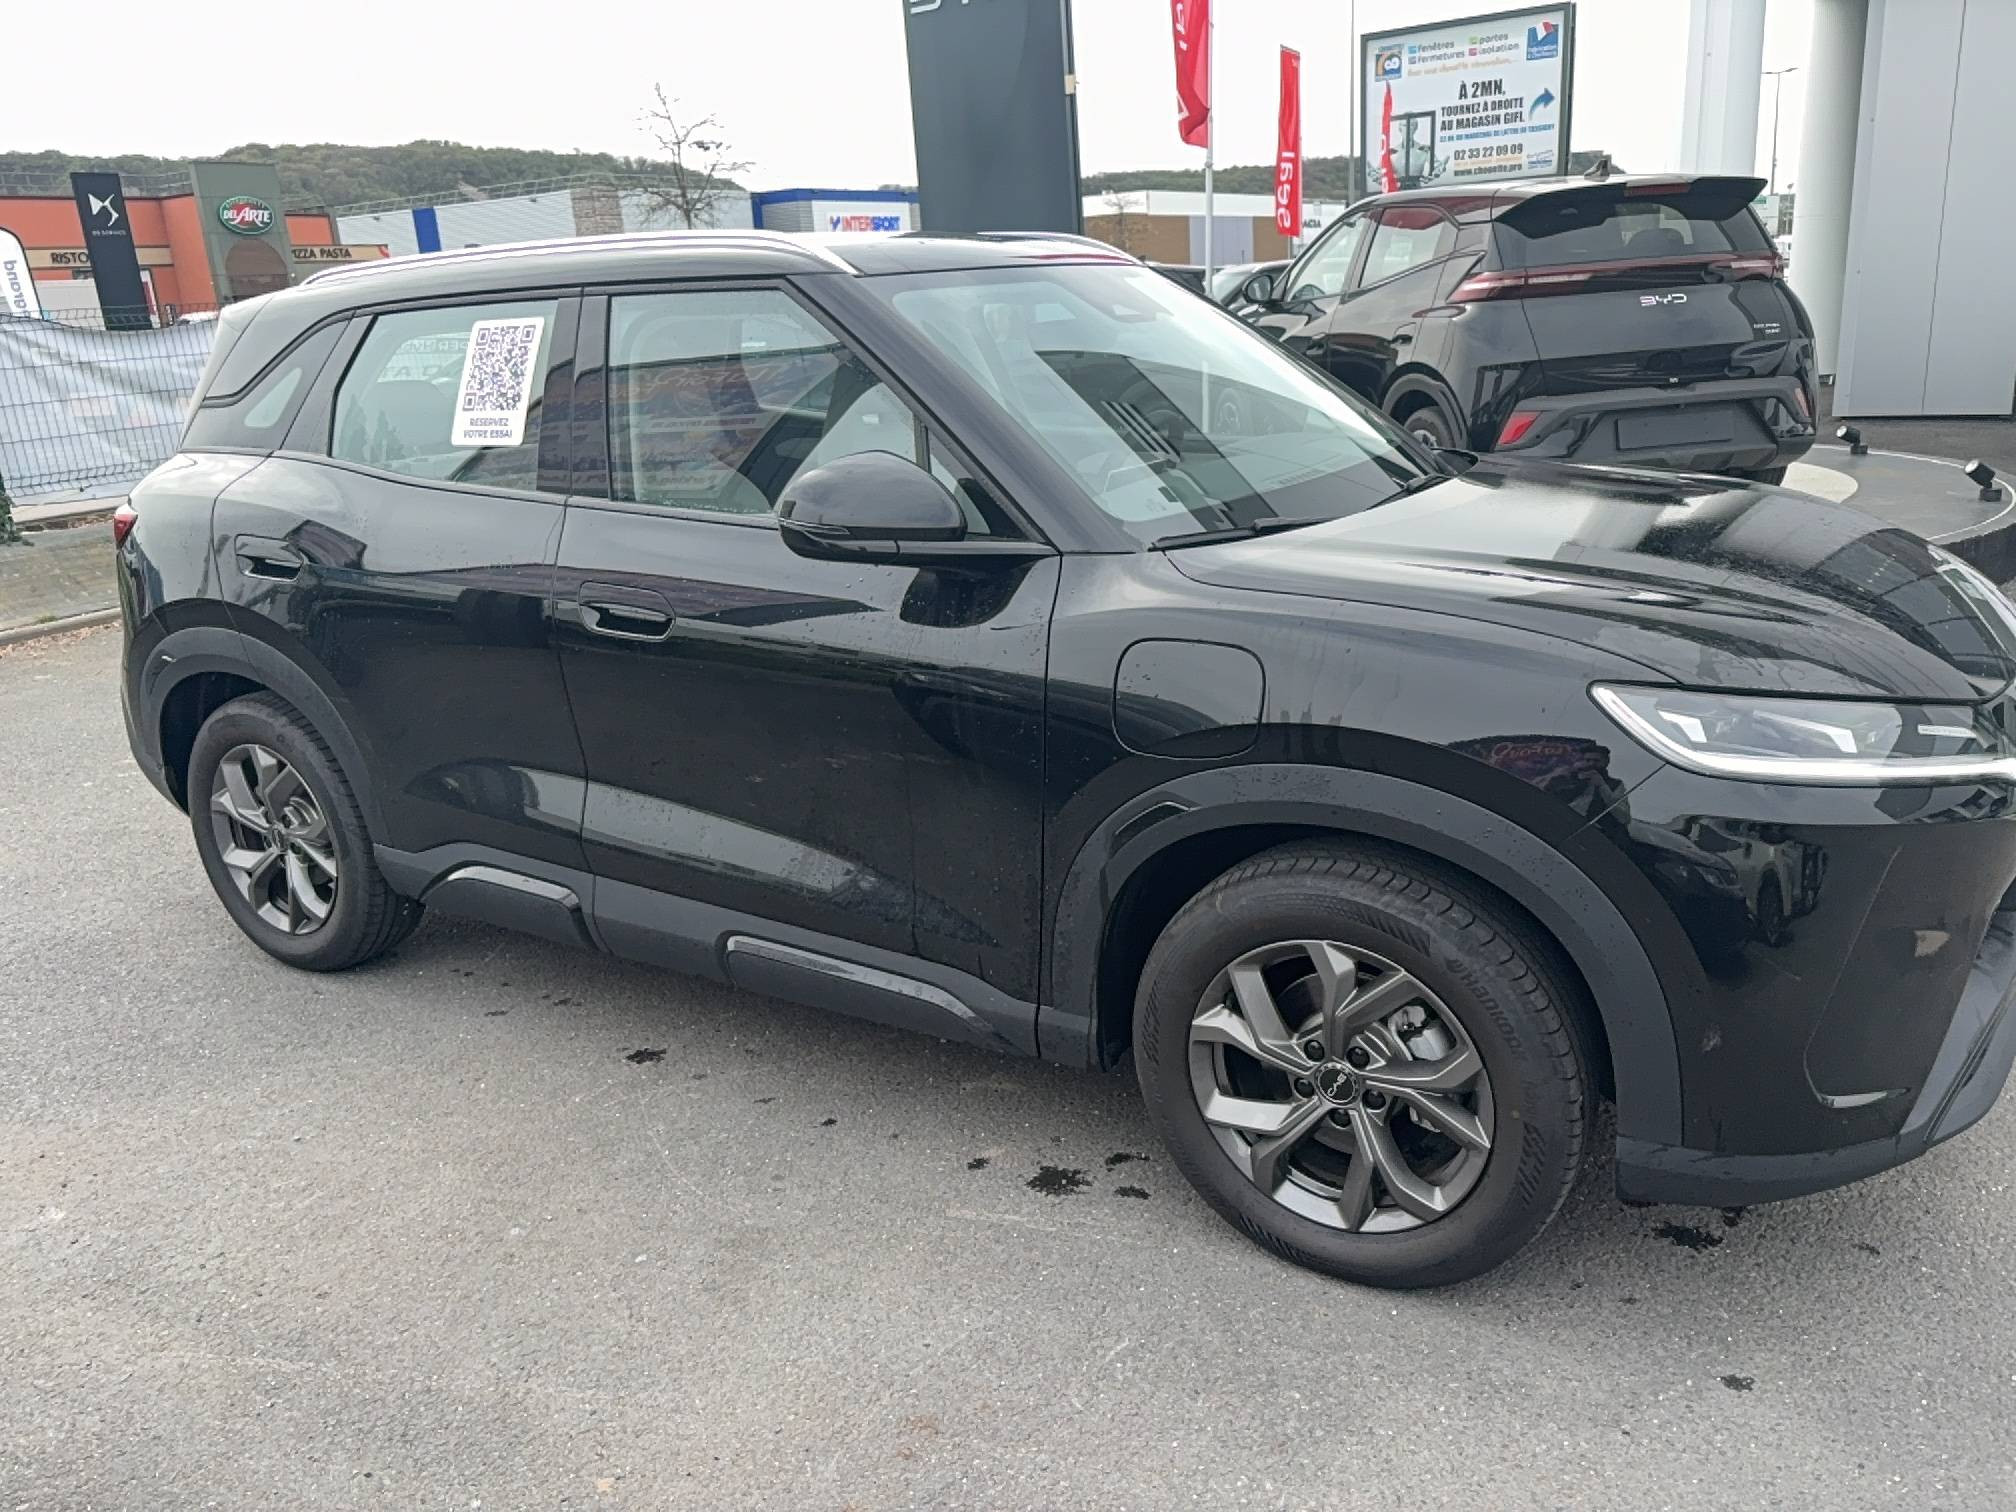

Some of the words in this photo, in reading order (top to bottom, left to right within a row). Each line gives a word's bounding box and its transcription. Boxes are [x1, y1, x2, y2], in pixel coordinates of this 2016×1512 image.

[1479, 33, 1509, 45] portes
[1441, 102, 1481, 117] TOURNEZ
[1491, 97, 1524, 111] DROITE
[1440, 120, 1454, 132] AU
[1456, 114, 1501, 130] MAGASIN
[1454, 149, 1466, 160] 02
[1467, 147, 1480, 158] 33
[1482, 145, 1494, 157] 22
[1496, 144, 1509, 156] 09
[1510, 142, 1523, 154] 09
[842, 215, 900, 232] INTERSPORT
[320, 247, 353, 259] PASTA
[1640, 293, 1687, 307] BYD
